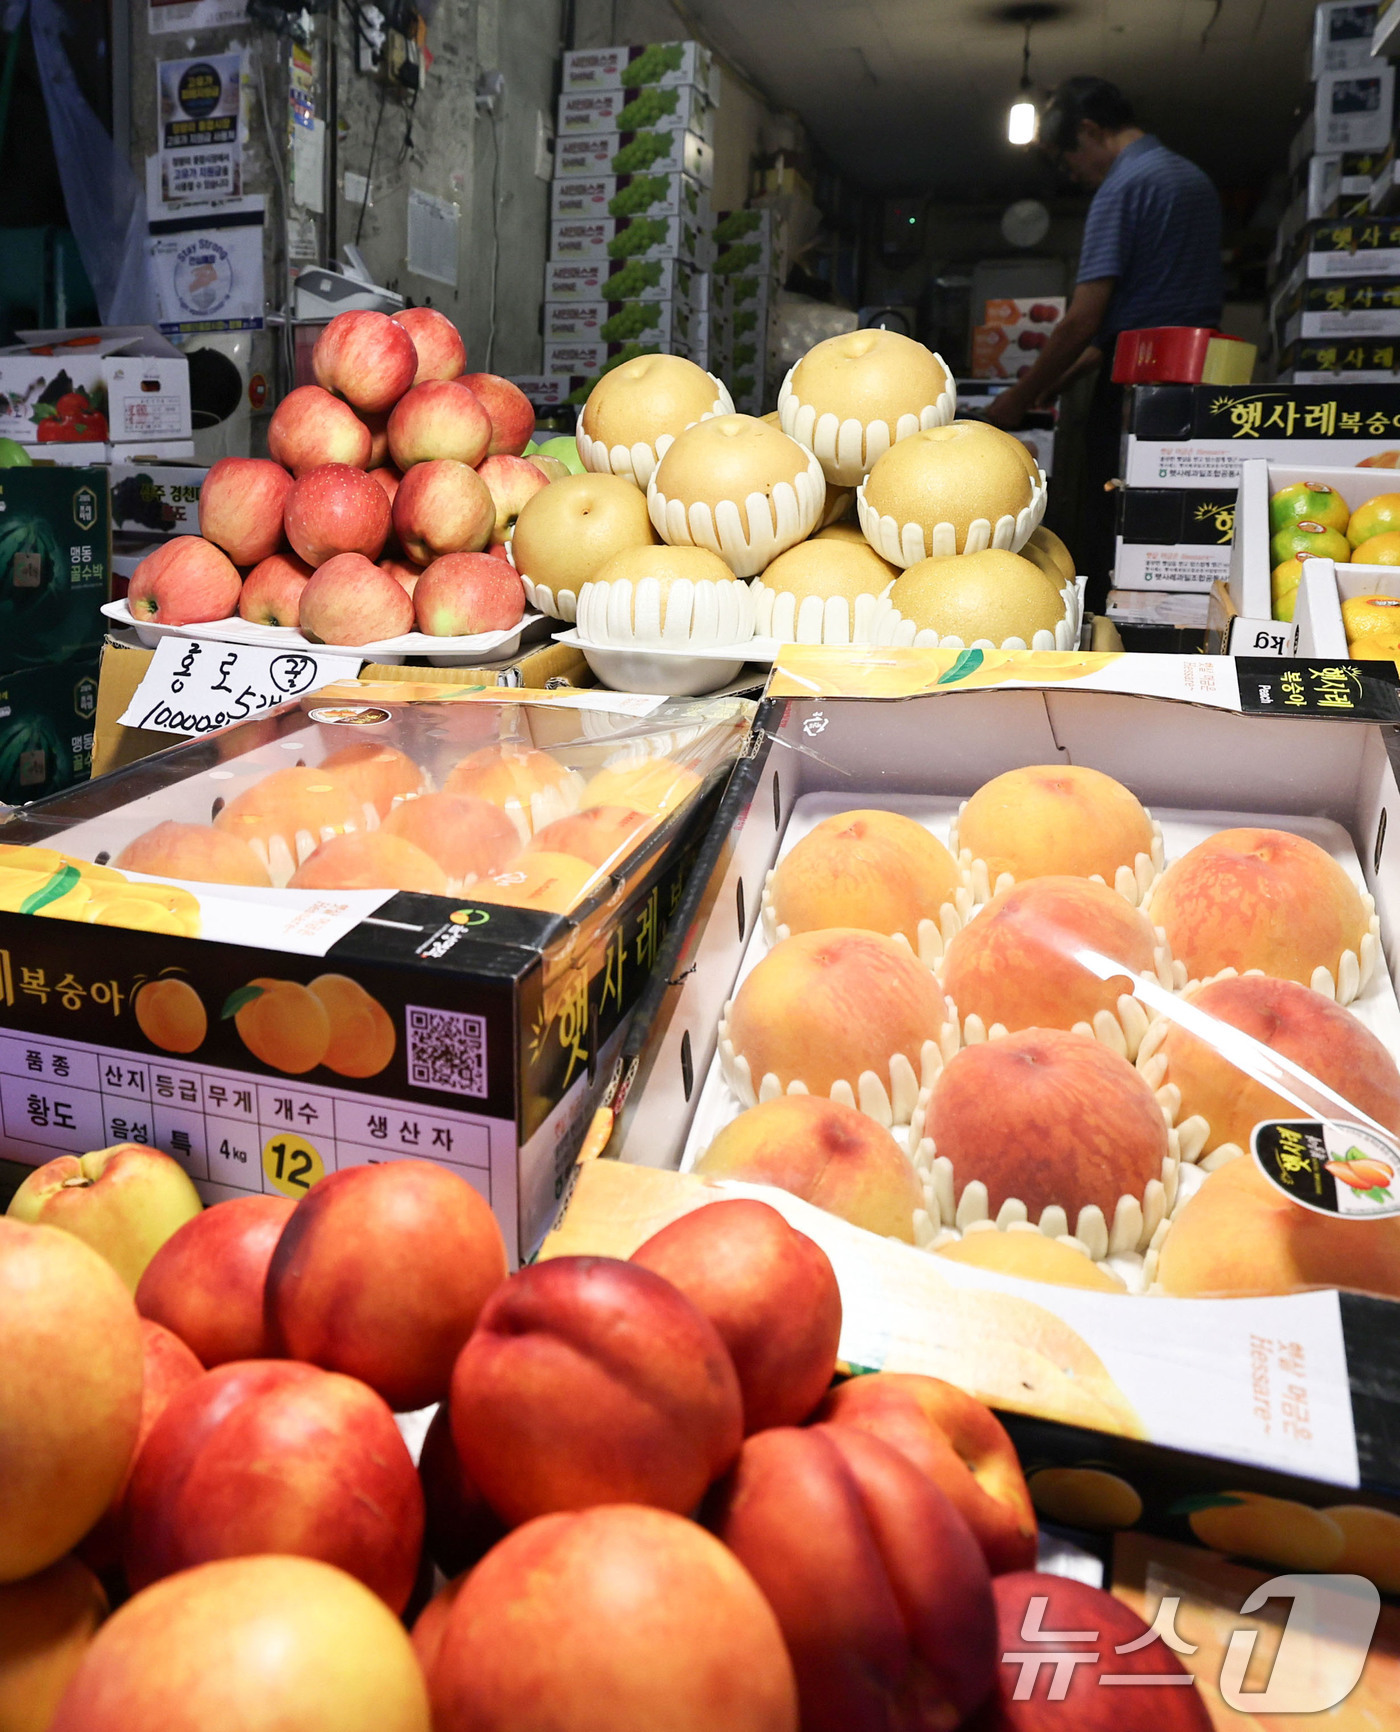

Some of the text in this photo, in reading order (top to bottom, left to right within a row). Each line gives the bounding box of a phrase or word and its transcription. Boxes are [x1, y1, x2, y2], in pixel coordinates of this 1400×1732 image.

[198, 238, 229, 262] Strong
[1316, 347, 1394, 370] 햇사레
[1230, 400, 1338, 439] 햇사레
[70, 546, 92, 563] 맹동
[71, 563, 104, 583] 꿀수박
[1253, 631, 1286, 655] kg
[1258, 683, 1275, 705] Peach
[1280, 670, 1308, 707] 복숭아
[1308, 666, 1355, 709] 햇사레
[71, 733, 93, 753] 맹동
[18, 966, 125, 1018] 복숭아
[558, 885, 658, 1090] 햇사레
[25, 1049, 454, 1152] 품종 산지 등급 무게 개수 생산자
[27, 1094, 77, 1131] 황도
[110, 1117, 149, 1145] 음성
[170, 1129, 192, 1158] 특
[271, 1142, 314, 1190] 12
[1275, 1125, 1313, 1174] 햇사레
[1278, 1339, 1314, 1441] 햇살 머금은
